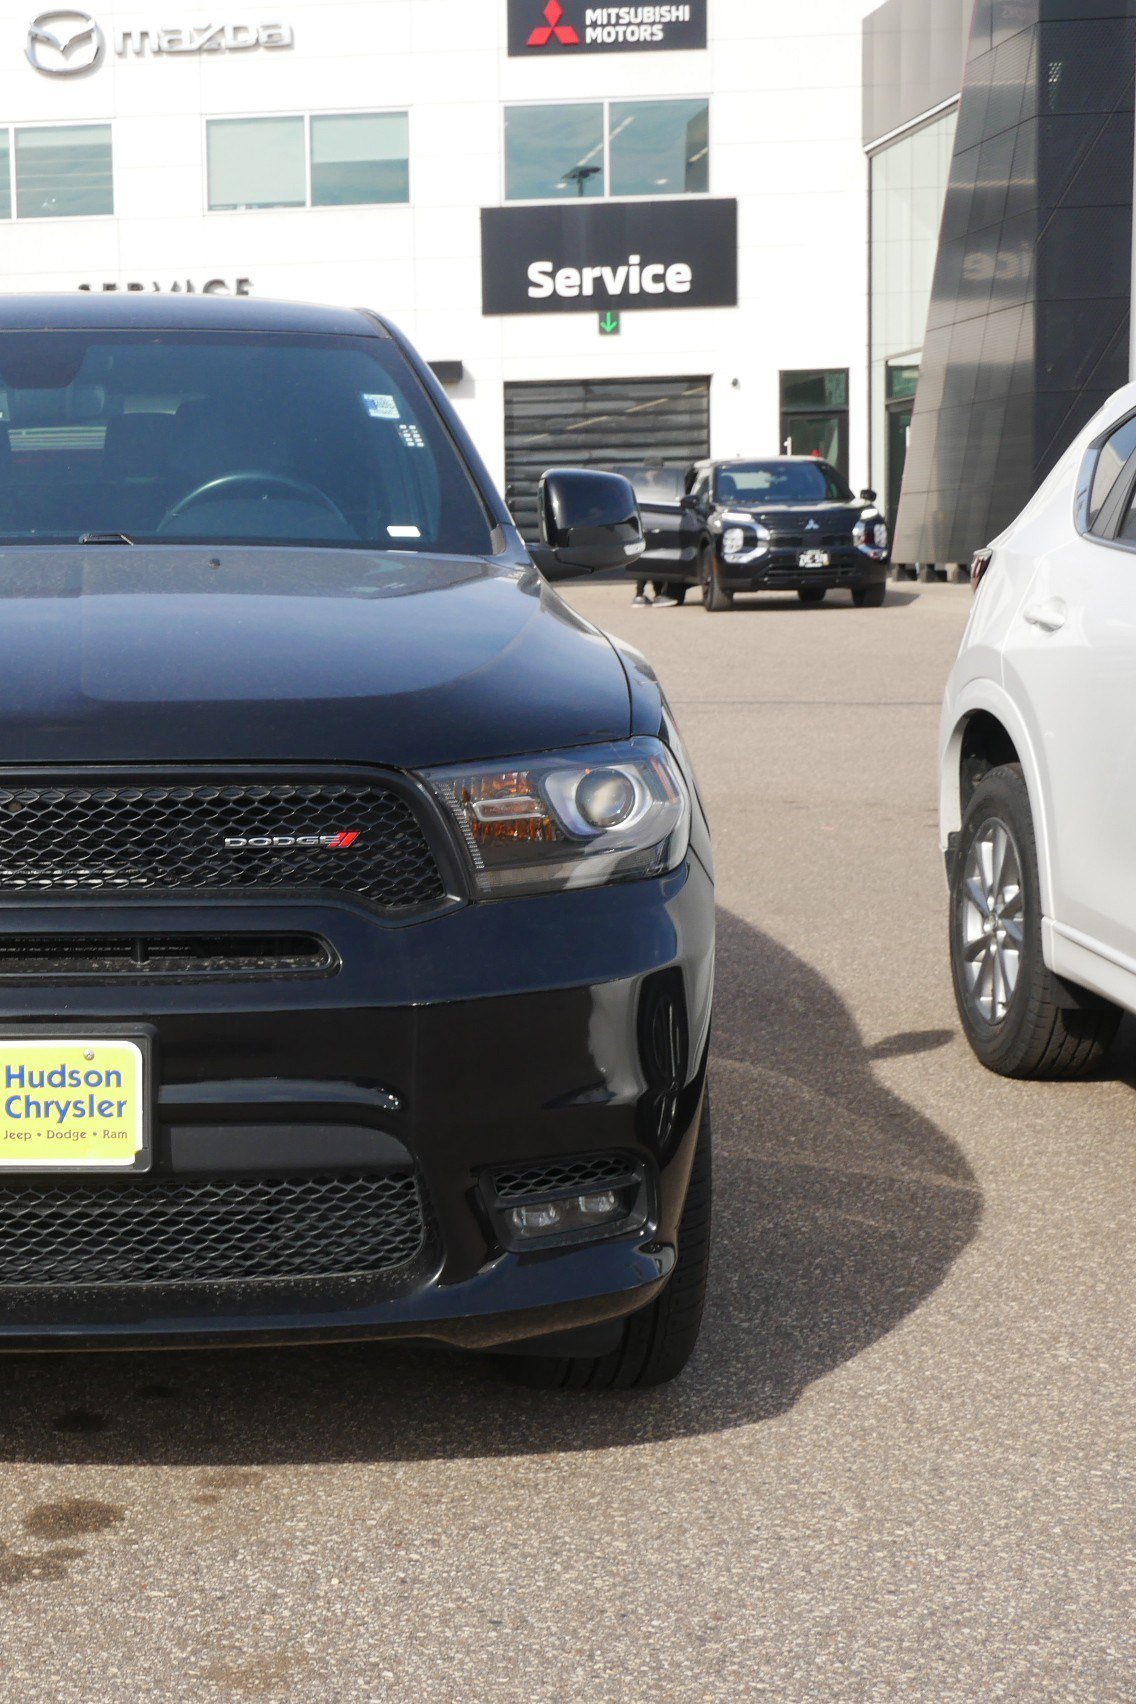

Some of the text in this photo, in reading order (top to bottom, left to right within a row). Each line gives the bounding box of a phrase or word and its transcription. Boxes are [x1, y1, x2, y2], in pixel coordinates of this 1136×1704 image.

[585, 4, 691, 25] MITSUBISHI
[114, 23, 294, 57] mazda
[585, 24, 664, 44] MOTORS
[527, 254, 692, 298] Service
[224, 835, 341, 848] DODGE
[5, 1064, 122, 1089] Hudson
[4, 1094, 127, 1124] Chrysler
[4, 1130, 128, 1141] Jeep Dodge Ram
